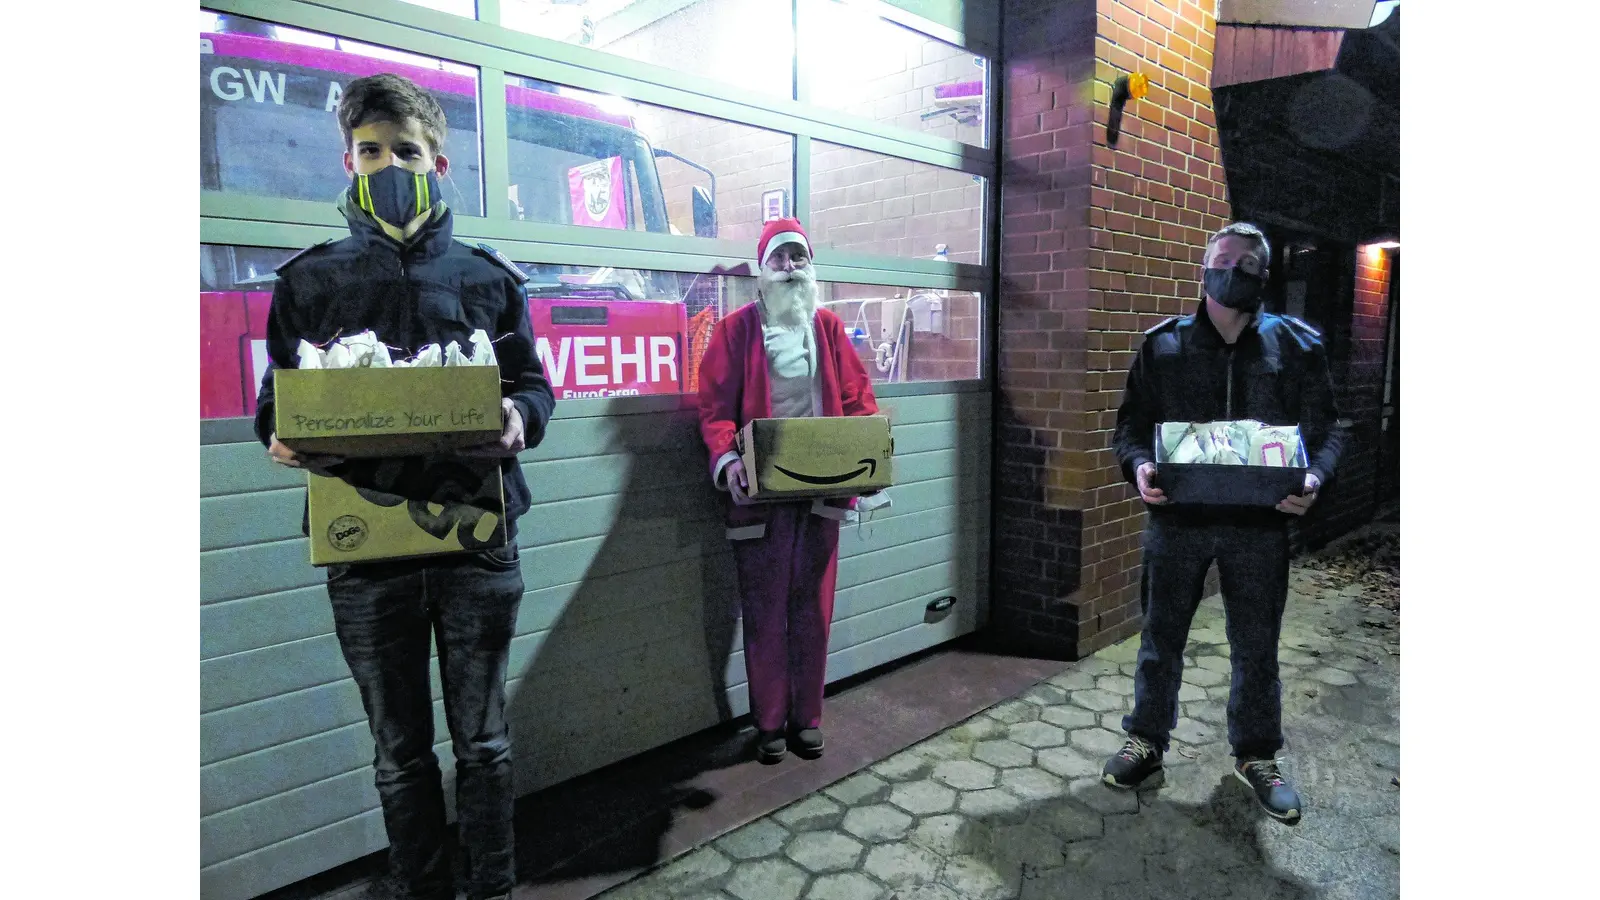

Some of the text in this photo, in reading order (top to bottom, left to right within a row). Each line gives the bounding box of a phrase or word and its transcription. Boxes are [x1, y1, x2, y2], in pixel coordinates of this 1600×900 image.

[210, 66, 286, 105] GW
[291, 408, 485, 431] Personalize Your Life
